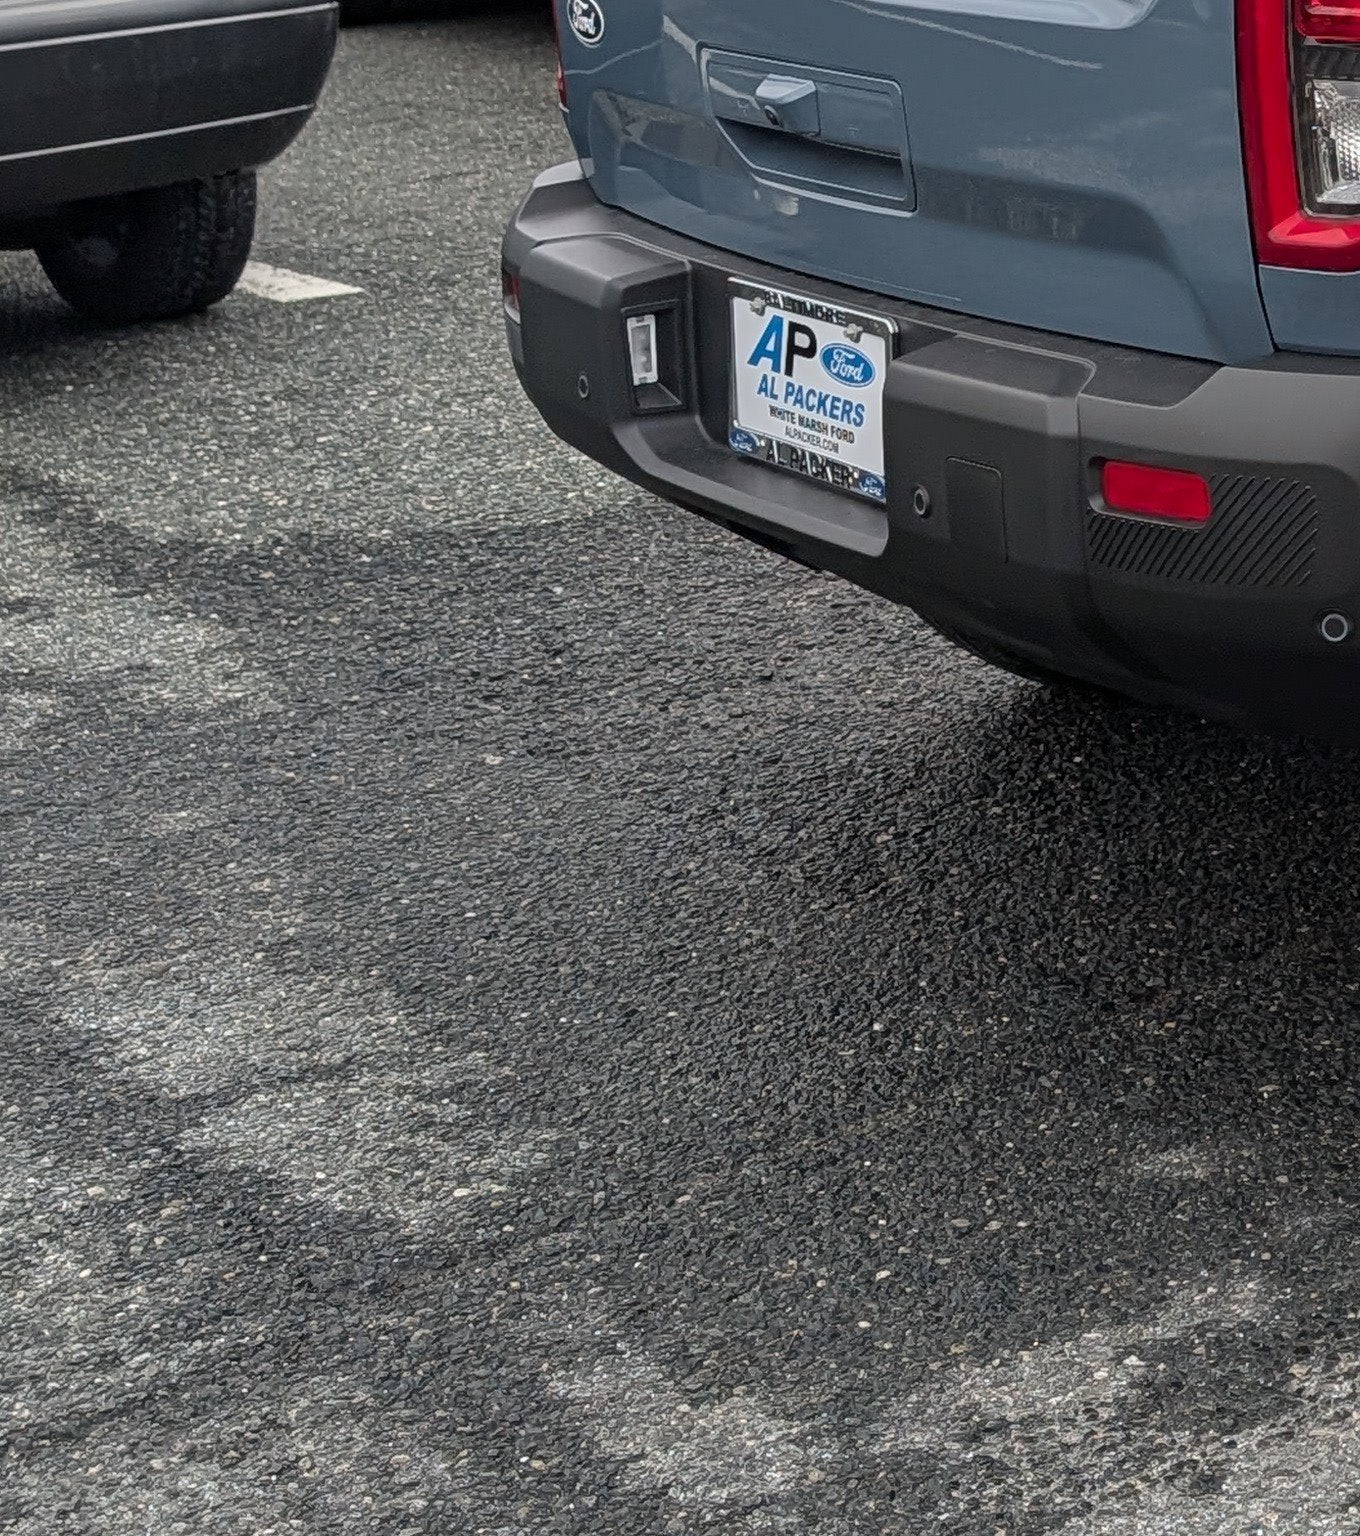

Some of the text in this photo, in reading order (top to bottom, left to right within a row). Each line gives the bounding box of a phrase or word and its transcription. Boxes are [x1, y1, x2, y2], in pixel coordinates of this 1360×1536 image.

[747, 314, 867, 383] AP Ford
[757, 373, 866, 428] AL PACKERS
[830, 425, 855, 444] FORD
